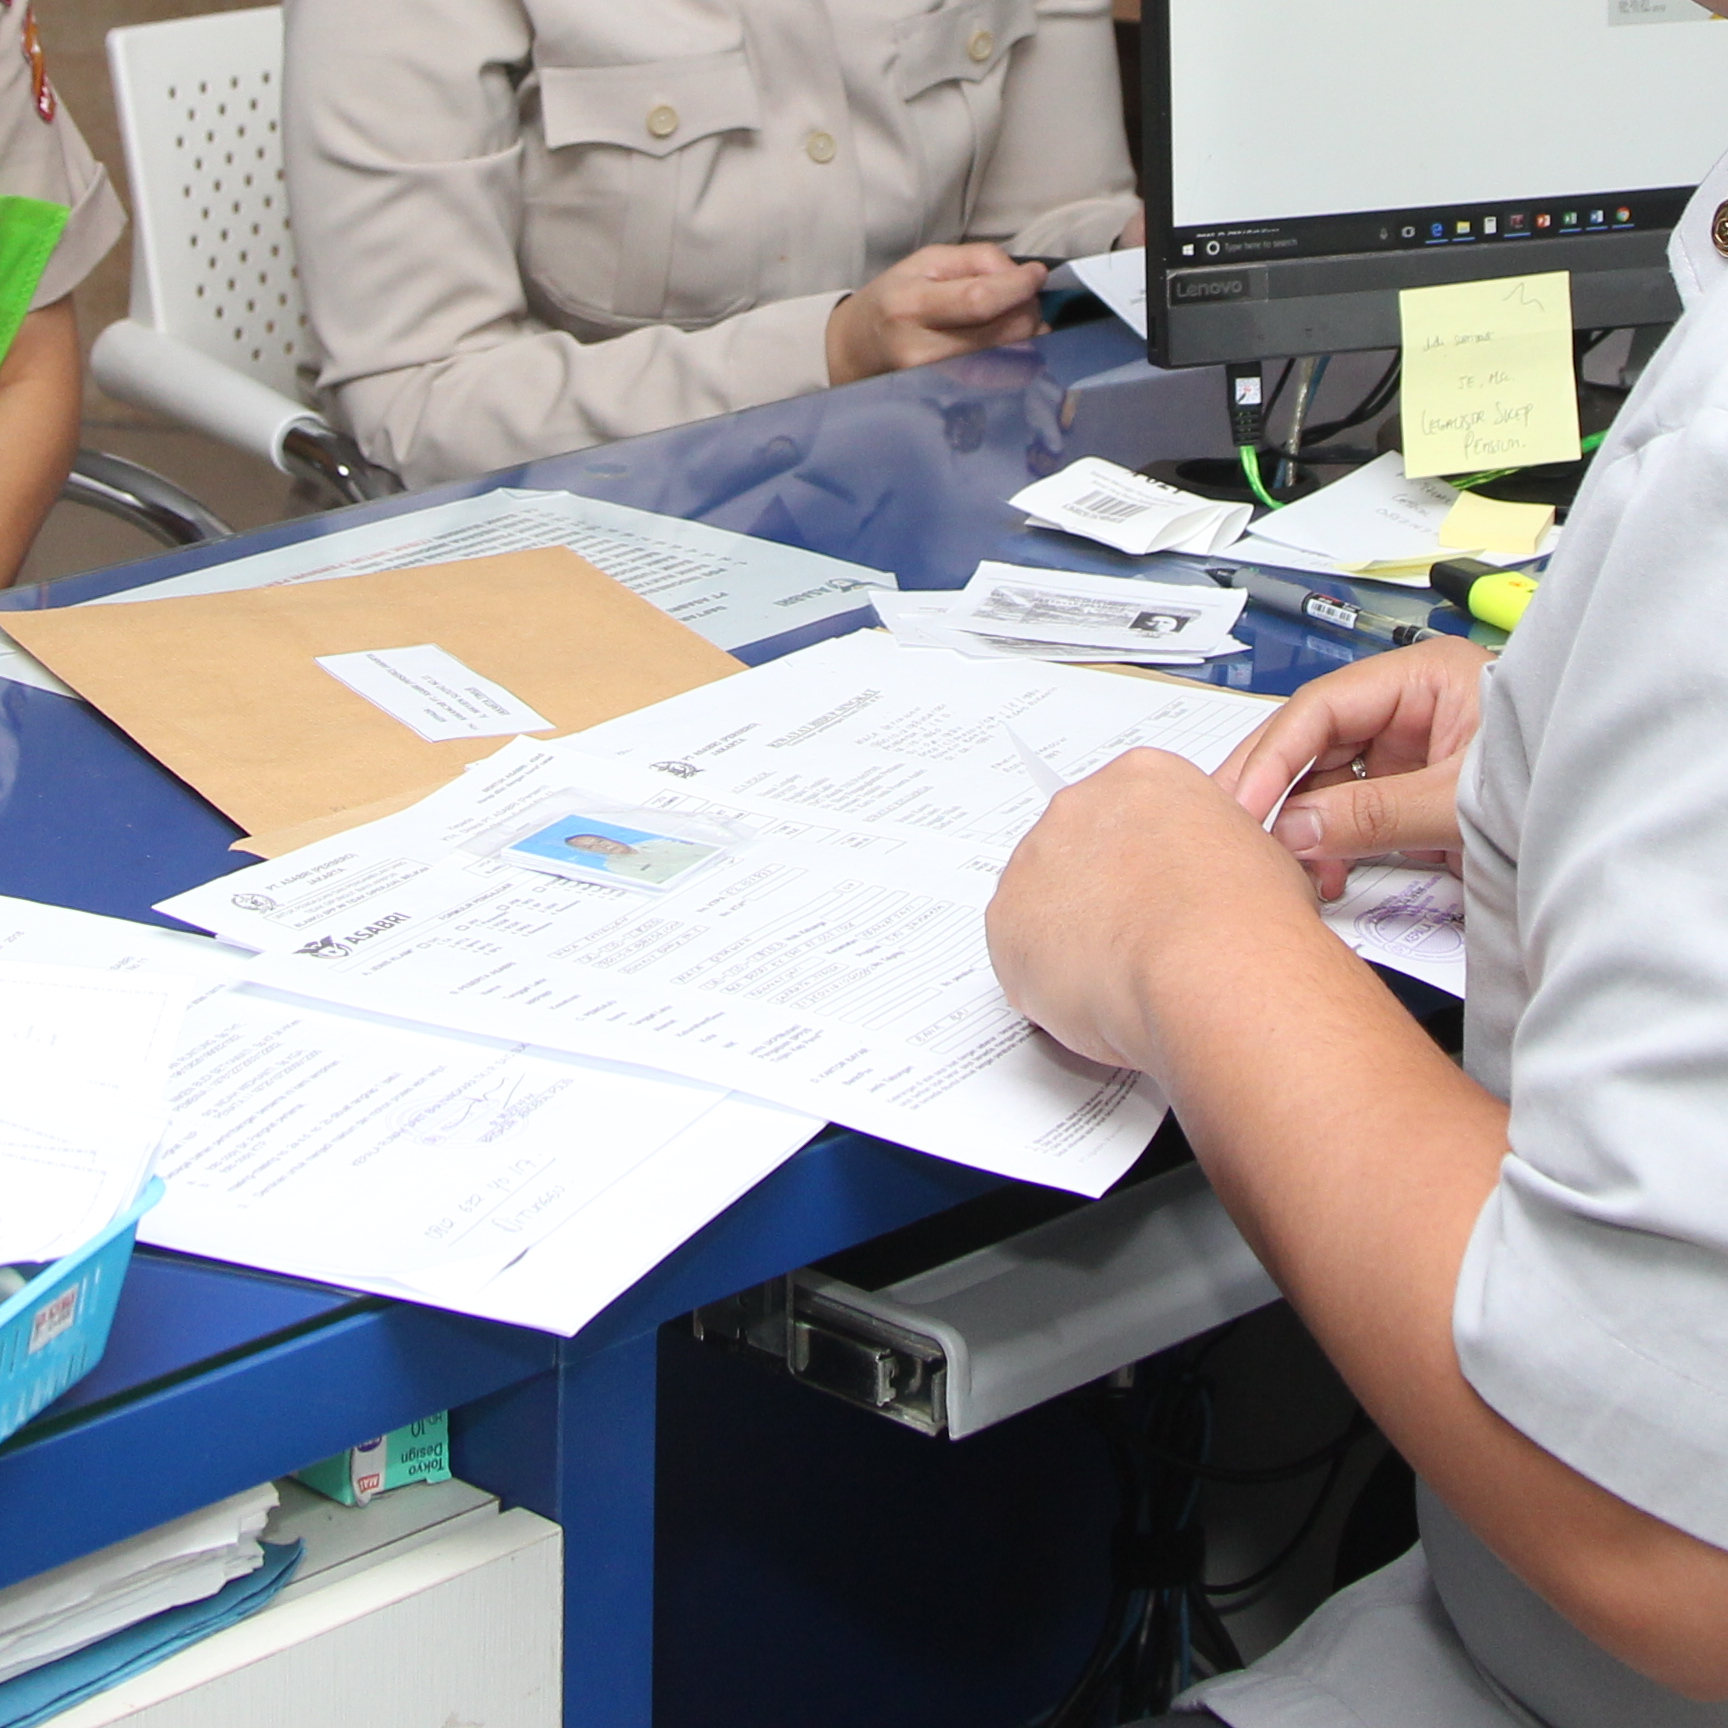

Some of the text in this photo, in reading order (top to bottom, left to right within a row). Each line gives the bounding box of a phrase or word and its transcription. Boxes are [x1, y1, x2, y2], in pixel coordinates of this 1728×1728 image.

[1176, 278, 1243, 298] Lenovo
[281, 870, 313, 886] ASABRI
[308, 868, 348, 886] JAKARTA
[343, 910, 412, 945] ASABRI
[401, 1442, 443, 1464] Design
[408, 1457, 444, 1476] Tokyo
